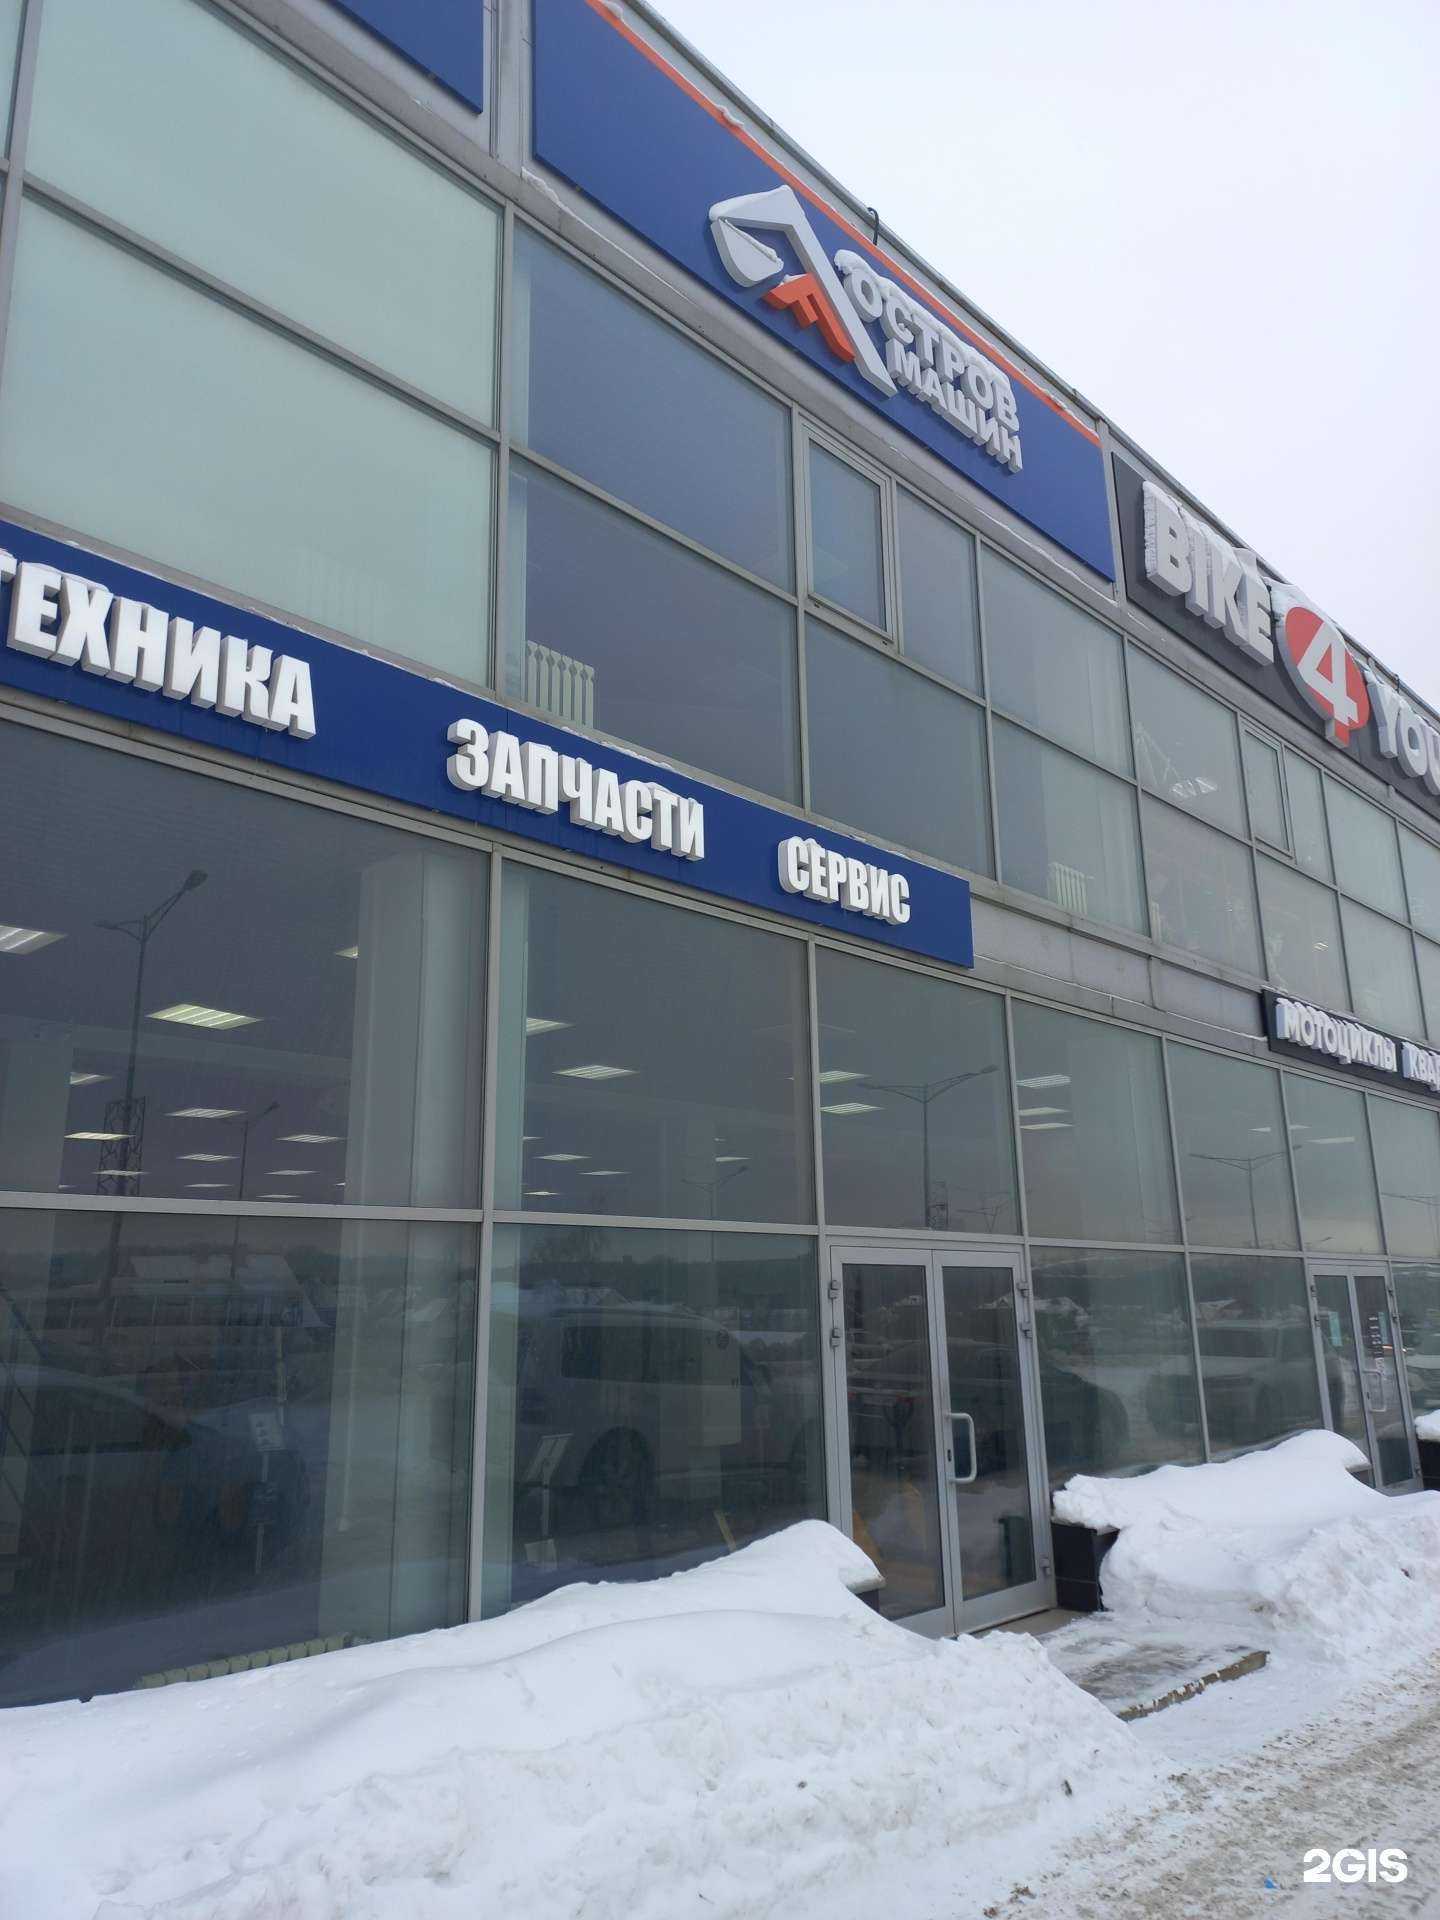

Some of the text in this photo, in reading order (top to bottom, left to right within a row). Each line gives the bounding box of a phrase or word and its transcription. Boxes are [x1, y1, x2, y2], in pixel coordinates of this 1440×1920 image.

[838, 253, 1020, 433] ОСТРОВ
[886, 337, 1023, 474] МАШИН
[1142, 481, 1274, 667] BIKE
[1296, 620, 1360, 728] 4
[446, 718, 705, 861] ЗАПЧАСТИ
[777, 836, 911, 926] СЕРВИС
[1275, 997, 1398, 1073] МОТОЦИКЛЫ
